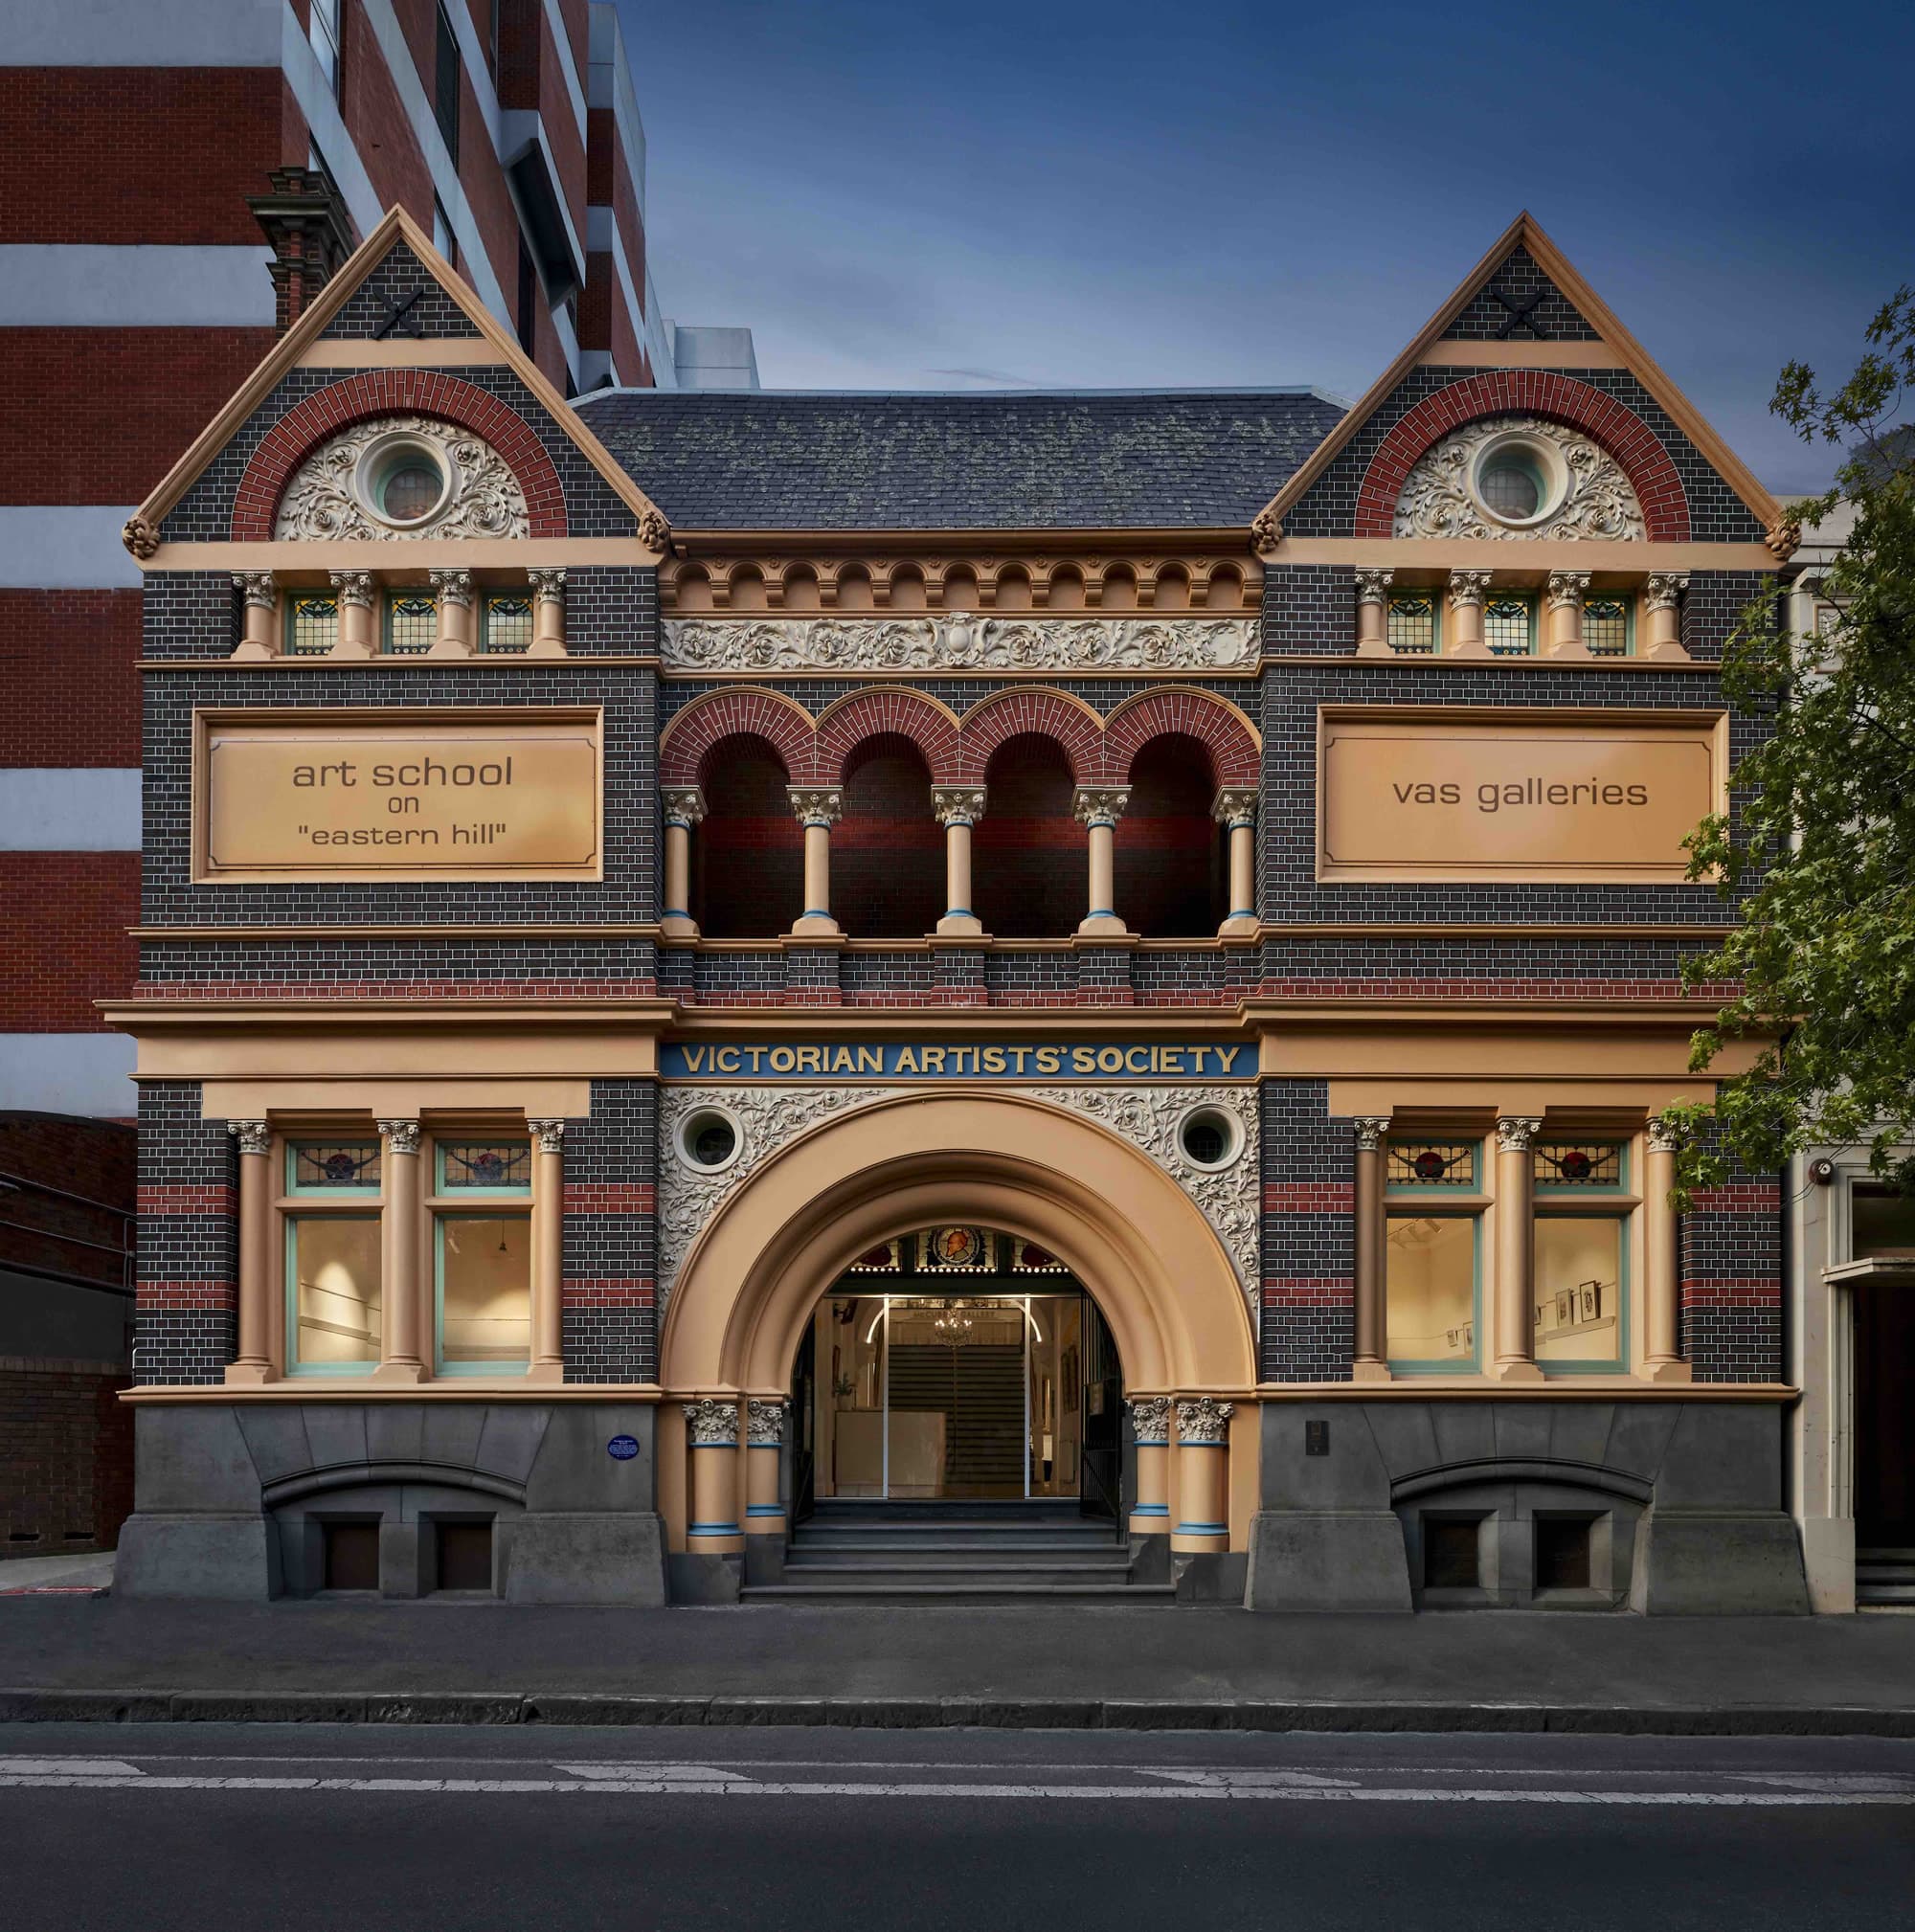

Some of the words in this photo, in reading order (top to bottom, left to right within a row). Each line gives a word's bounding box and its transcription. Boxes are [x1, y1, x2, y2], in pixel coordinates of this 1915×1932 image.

[292, 760, 357, 787] art
[372, 755, 512, 787] school
[388, 797, 419, 814] on
[1392, 783, 1461, 805] vas
[1477, 776, 1648, 813] galleries
[298, 824, 439, 845] "eastern
[452, 822, 507, 844] hill"
[681, 1045, 884, 1073] VICTORIAN
[1071, 1045, 1240, 1074] SOCIETY
